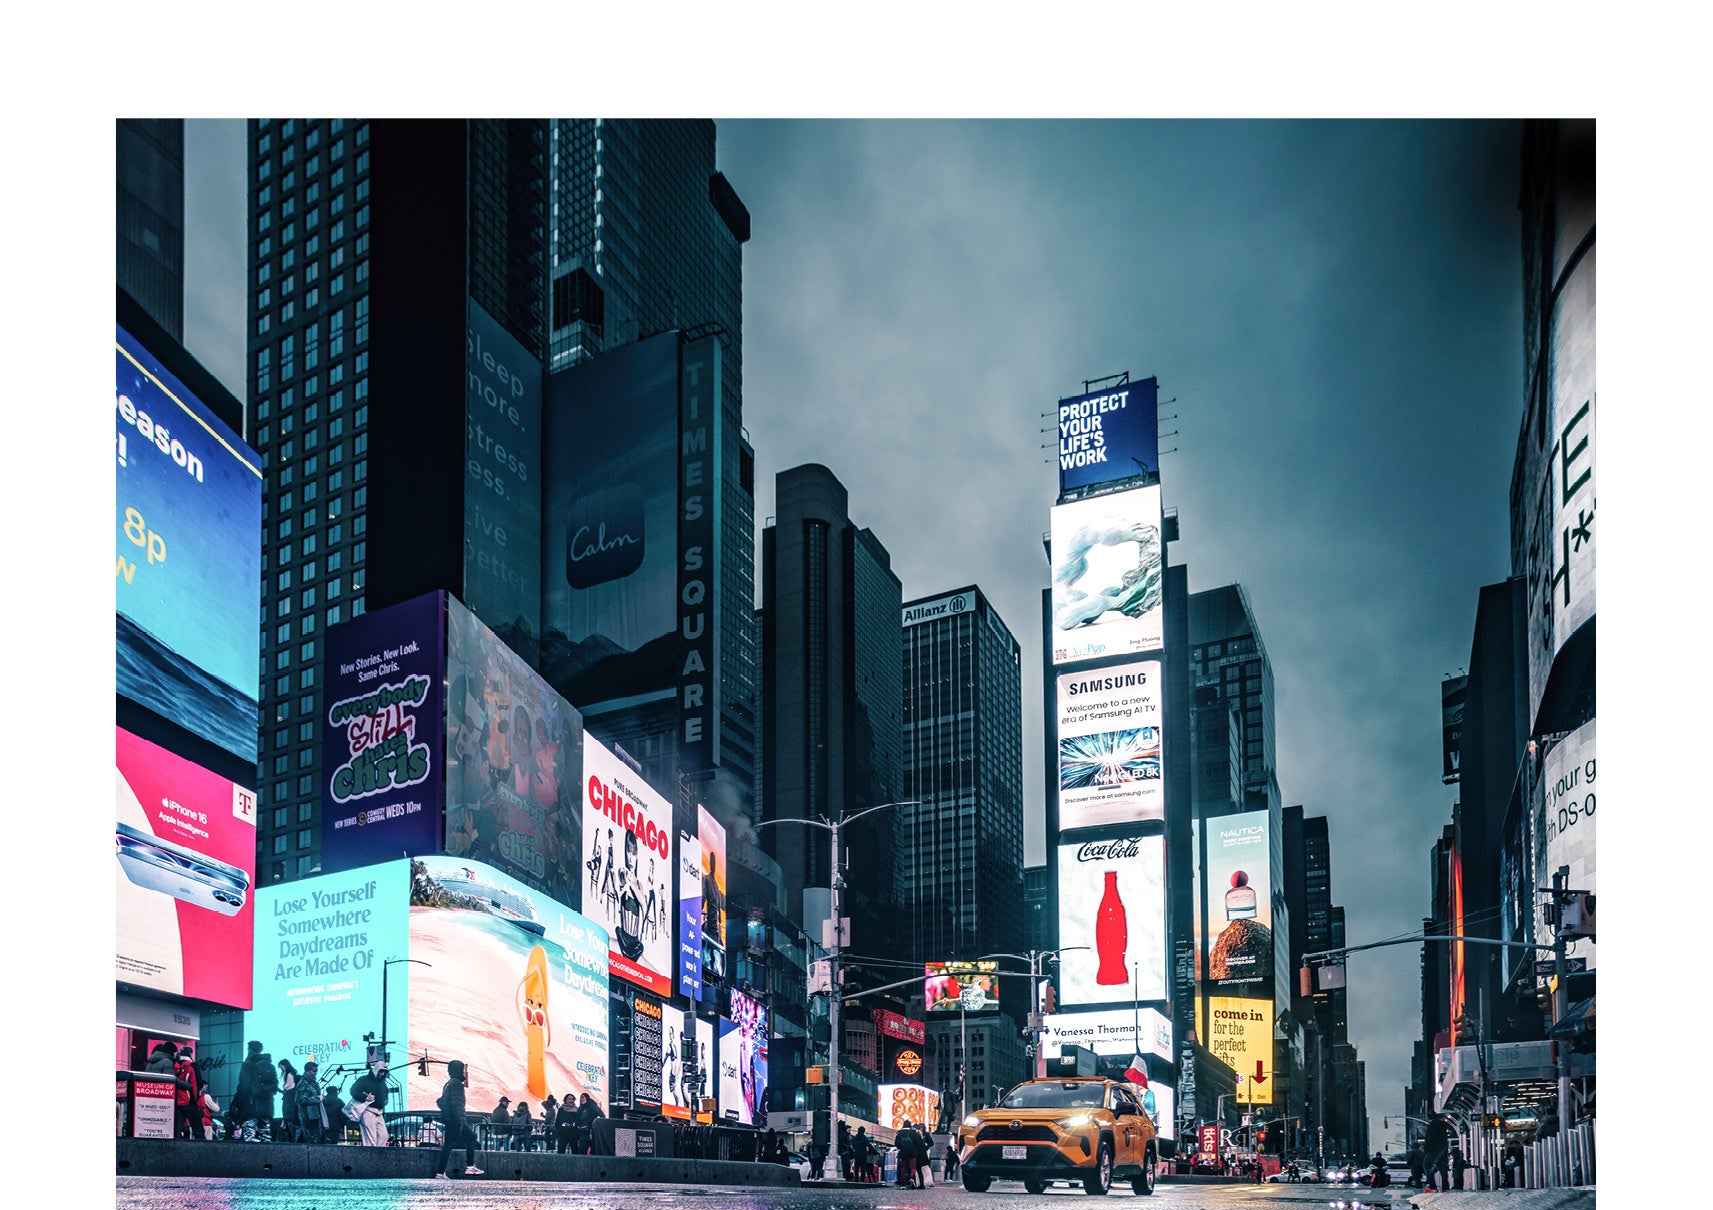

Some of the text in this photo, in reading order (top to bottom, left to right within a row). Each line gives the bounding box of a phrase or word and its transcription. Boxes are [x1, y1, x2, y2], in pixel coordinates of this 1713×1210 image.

[1060, 391, 1129, 422] PROTECT
[116, 393, 203, 483] eason
[1060, 415, 1102, 438] YOUR
[1060, 430, 1105, 455] LIFE'S
[1060, 446, 1108, 470] WORK
[468, 460, 510, 501] ess.
[123, 505, 167, 566] 8p
[466, 505, 507, 546] ive
[570, 522, 639, 562] Calm
[682, 362, 706, 743] TIMES SQUARE
[904, 604, 947, 623] Allianz
[340, 641, 420, 675] New Stories. New Look.
[358, 661, 400, 683] Same Chris.
[1069, 672, 1147, 696] SAMSUNG
[331, 677, 428, 724] everybody
[1066, 702, 1108, 713] Welcome
[1130, 696, 1150, 704] new
[1078, 714, 1088, 722] of
[1089, 708, 1132, 720] Samsung
[1145, 704, 1156, 712] TV
[1146, 767, 1159, 777] 8K
[613, 778, 626, 794] PURE
[1552, 766, 1581, 808] your
[168, 799, 207, 824] iPhone 16
[386, 803, 405, 819] WEDS
[406, 801, 421, 814] 10PM
[1065, 796, 1089, 804] Discover
[159, 811, 209, 838] Apple Intelligence
[588, 774, 669, 860] CHICAGO
[1219, 825, 1264, 838] NAUTICA
[273, 881, 377, 917] Lose Yourself
[278, 908, 371, 937] Somewhere
[559, 913, 584, 943] Lose
[280, 932, 367, 960] Daydreams
[274, 949, 375, 981] Are Made Of
[686, 960, 697, 973] wok
[635, 998, 661, 1020] CHICAGO
[1214, 1009, 1263, 1021] come in
[1054, 1023, 1142, 1037] Vanessa Thorman
[1214, 1019, 1244, 1036] for the
[293, 1040, 352, 1056] CELEBRATION
[1213, 1037, 1247, 1053] perfect
[314, 1053, 331, 1064] KEY
[1203, 1127, 1214, 1152] tkts
